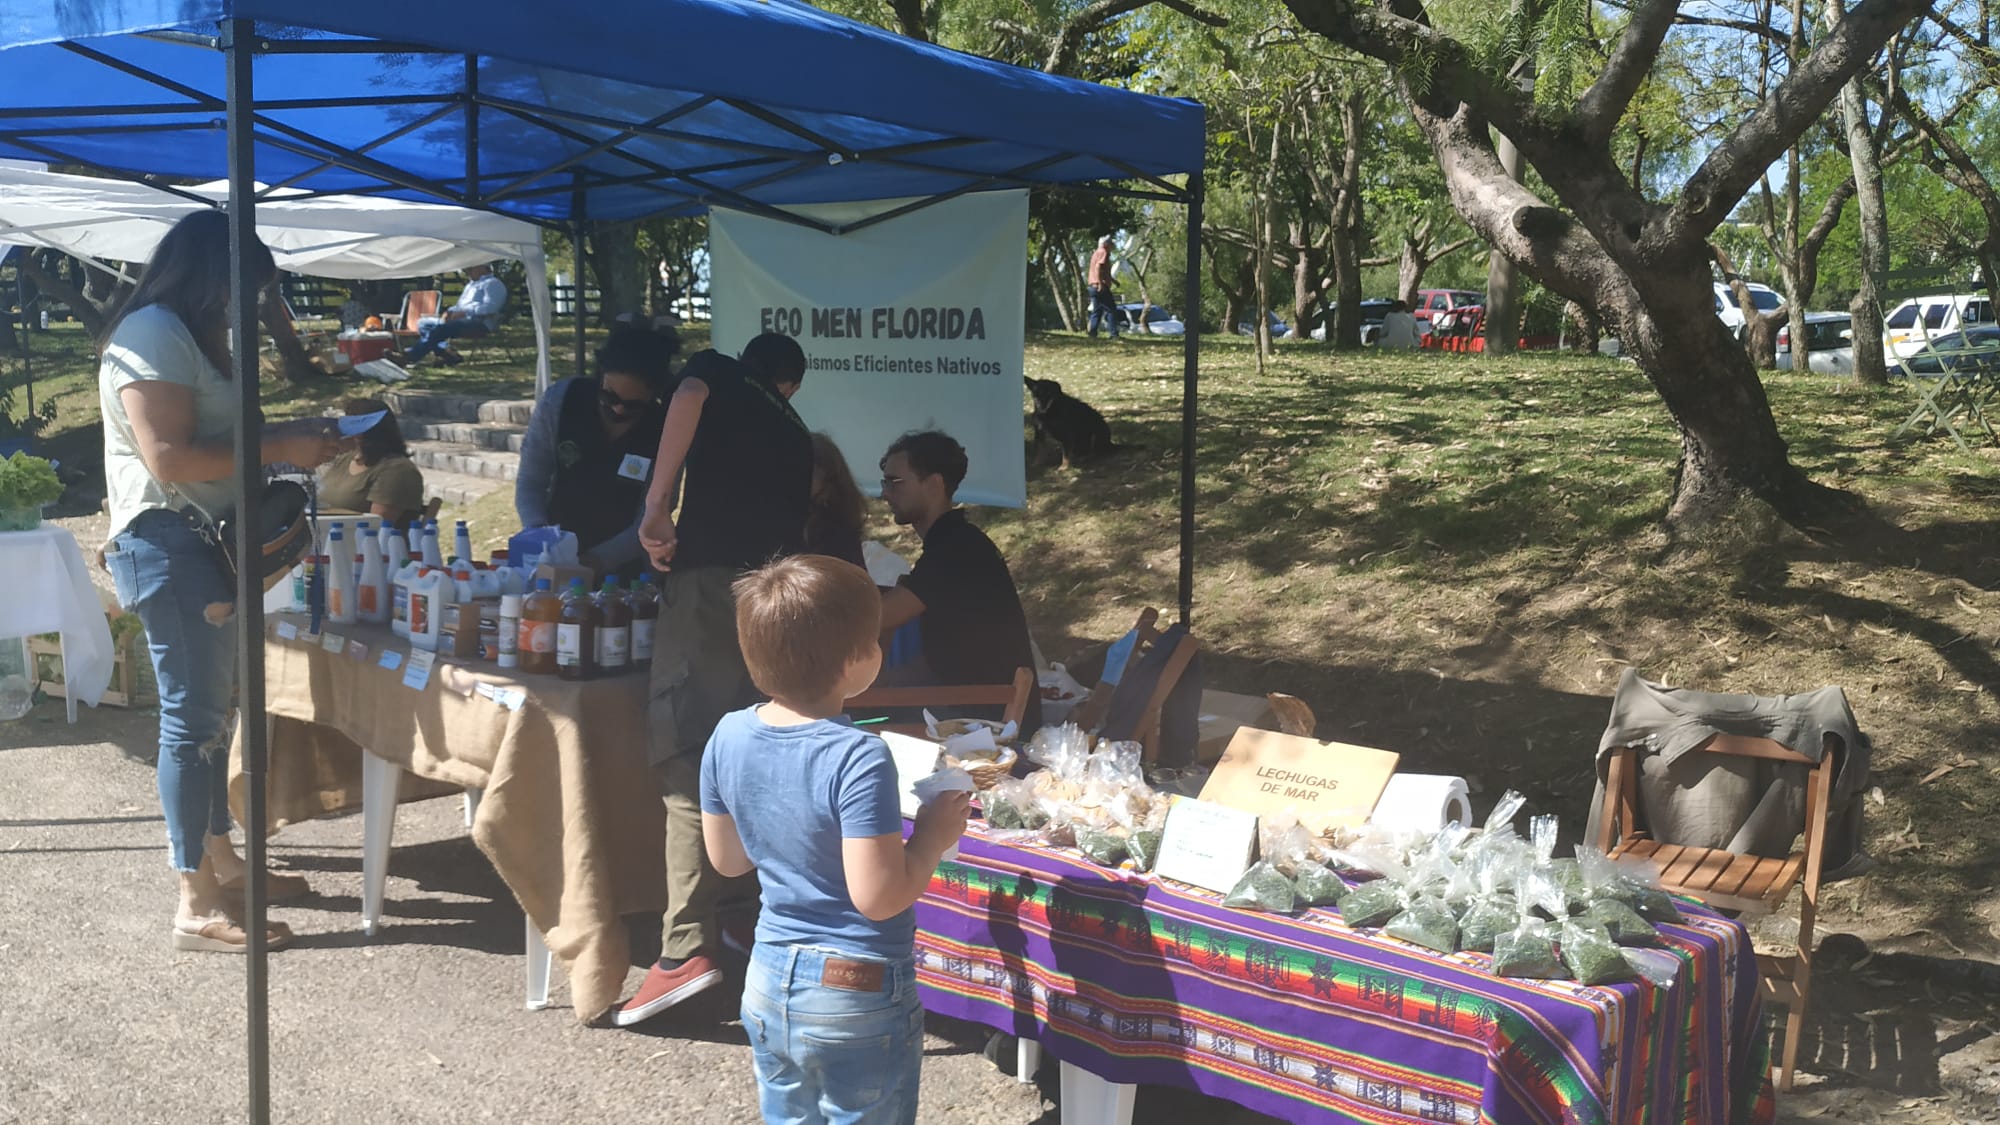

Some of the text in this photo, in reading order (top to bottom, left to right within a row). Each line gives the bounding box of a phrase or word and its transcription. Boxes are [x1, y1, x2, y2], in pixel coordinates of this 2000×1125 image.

[760, 307, 986, 340] ECO MEN FLORIDA
[854, 355, 933, 373] Eficientes
[937, 357, 1001, 375] Nativos
[1256, 766, 1339, 790] LECHUGAS
[1260, 782, 1319, 802] DE MAR
